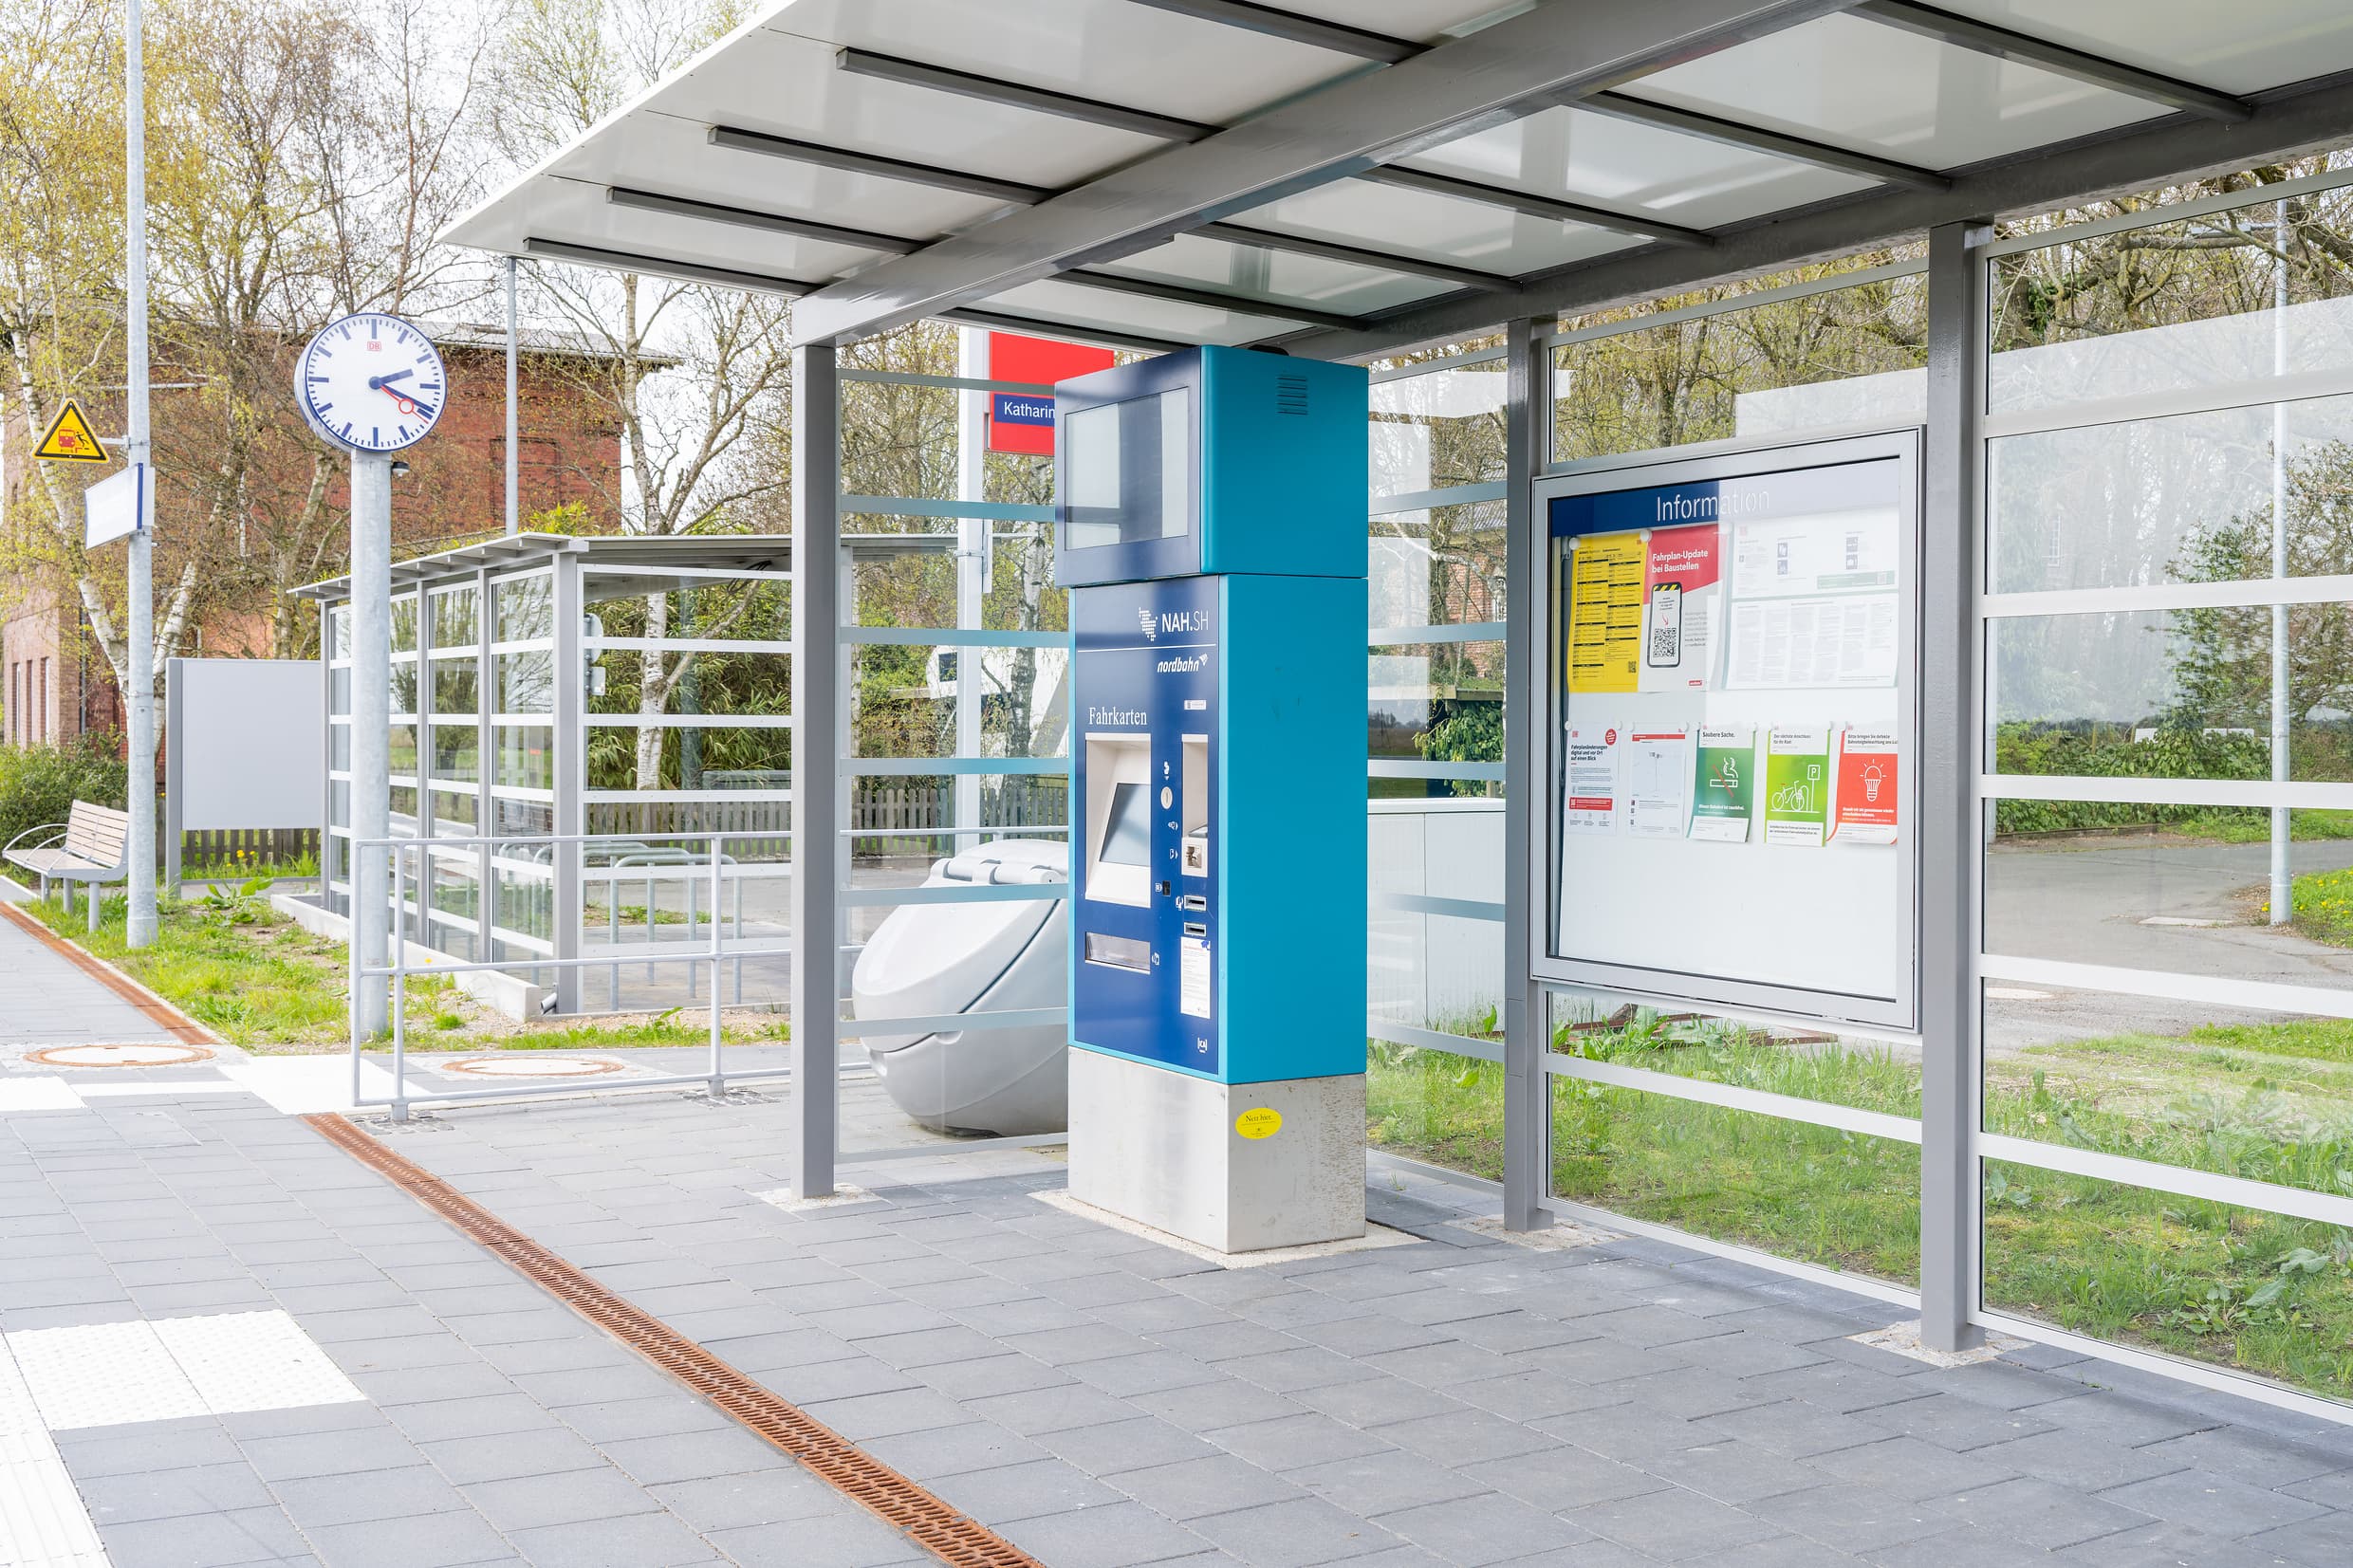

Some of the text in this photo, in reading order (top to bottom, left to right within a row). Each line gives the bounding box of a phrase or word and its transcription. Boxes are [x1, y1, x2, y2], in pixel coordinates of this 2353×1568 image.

[1657, 491, 1769, 522] Information
[1653, 550, 1709, 562] Fahrplan-Update
[1652, 562, 1699, 573] bei Baustellen
[1161, 610, 1209, 633] NAH.SH
[1157, 656, 1199, 673] nordbahn
[1088, 707, 1147, 726] Fahrkarten
